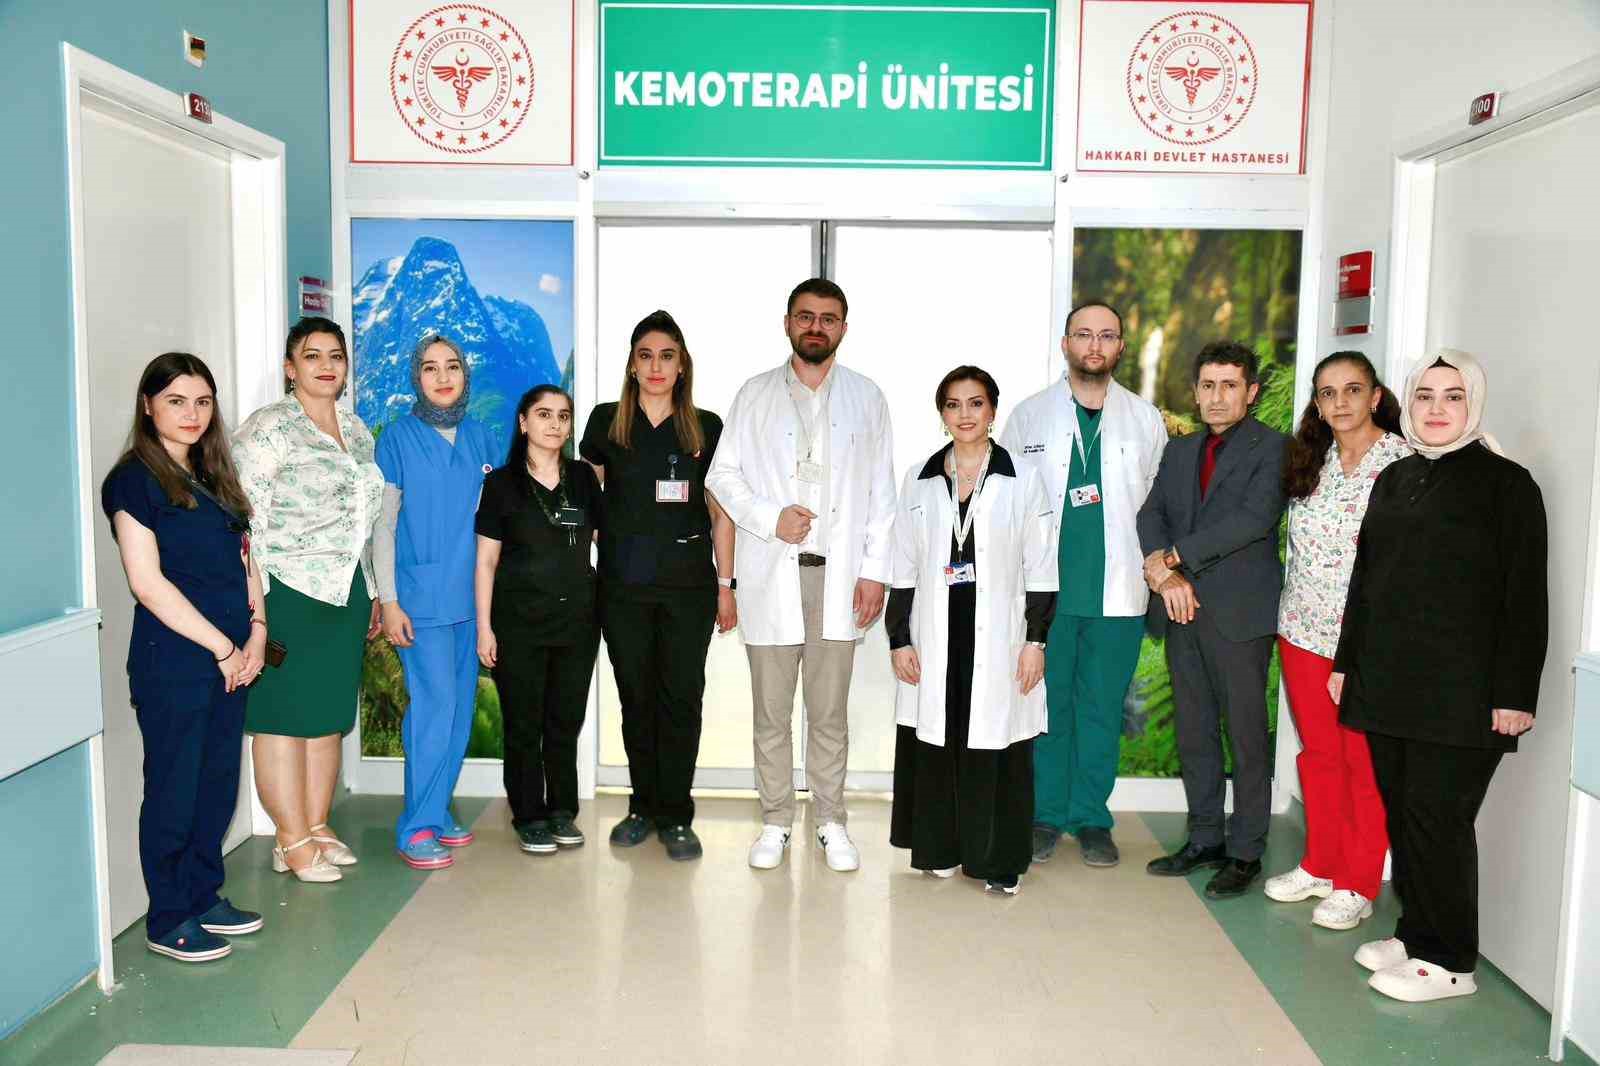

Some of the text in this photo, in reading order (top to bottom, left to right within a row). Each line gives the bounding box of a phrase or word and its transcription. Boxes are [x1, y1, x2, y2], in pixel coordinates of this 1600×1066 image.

[614, 61, 1034, 112] KEMOTERAPİ ÜNİTESİ
[1085, 150, 1289, 164] HAKKARİ DEVLET HASTANESİ
